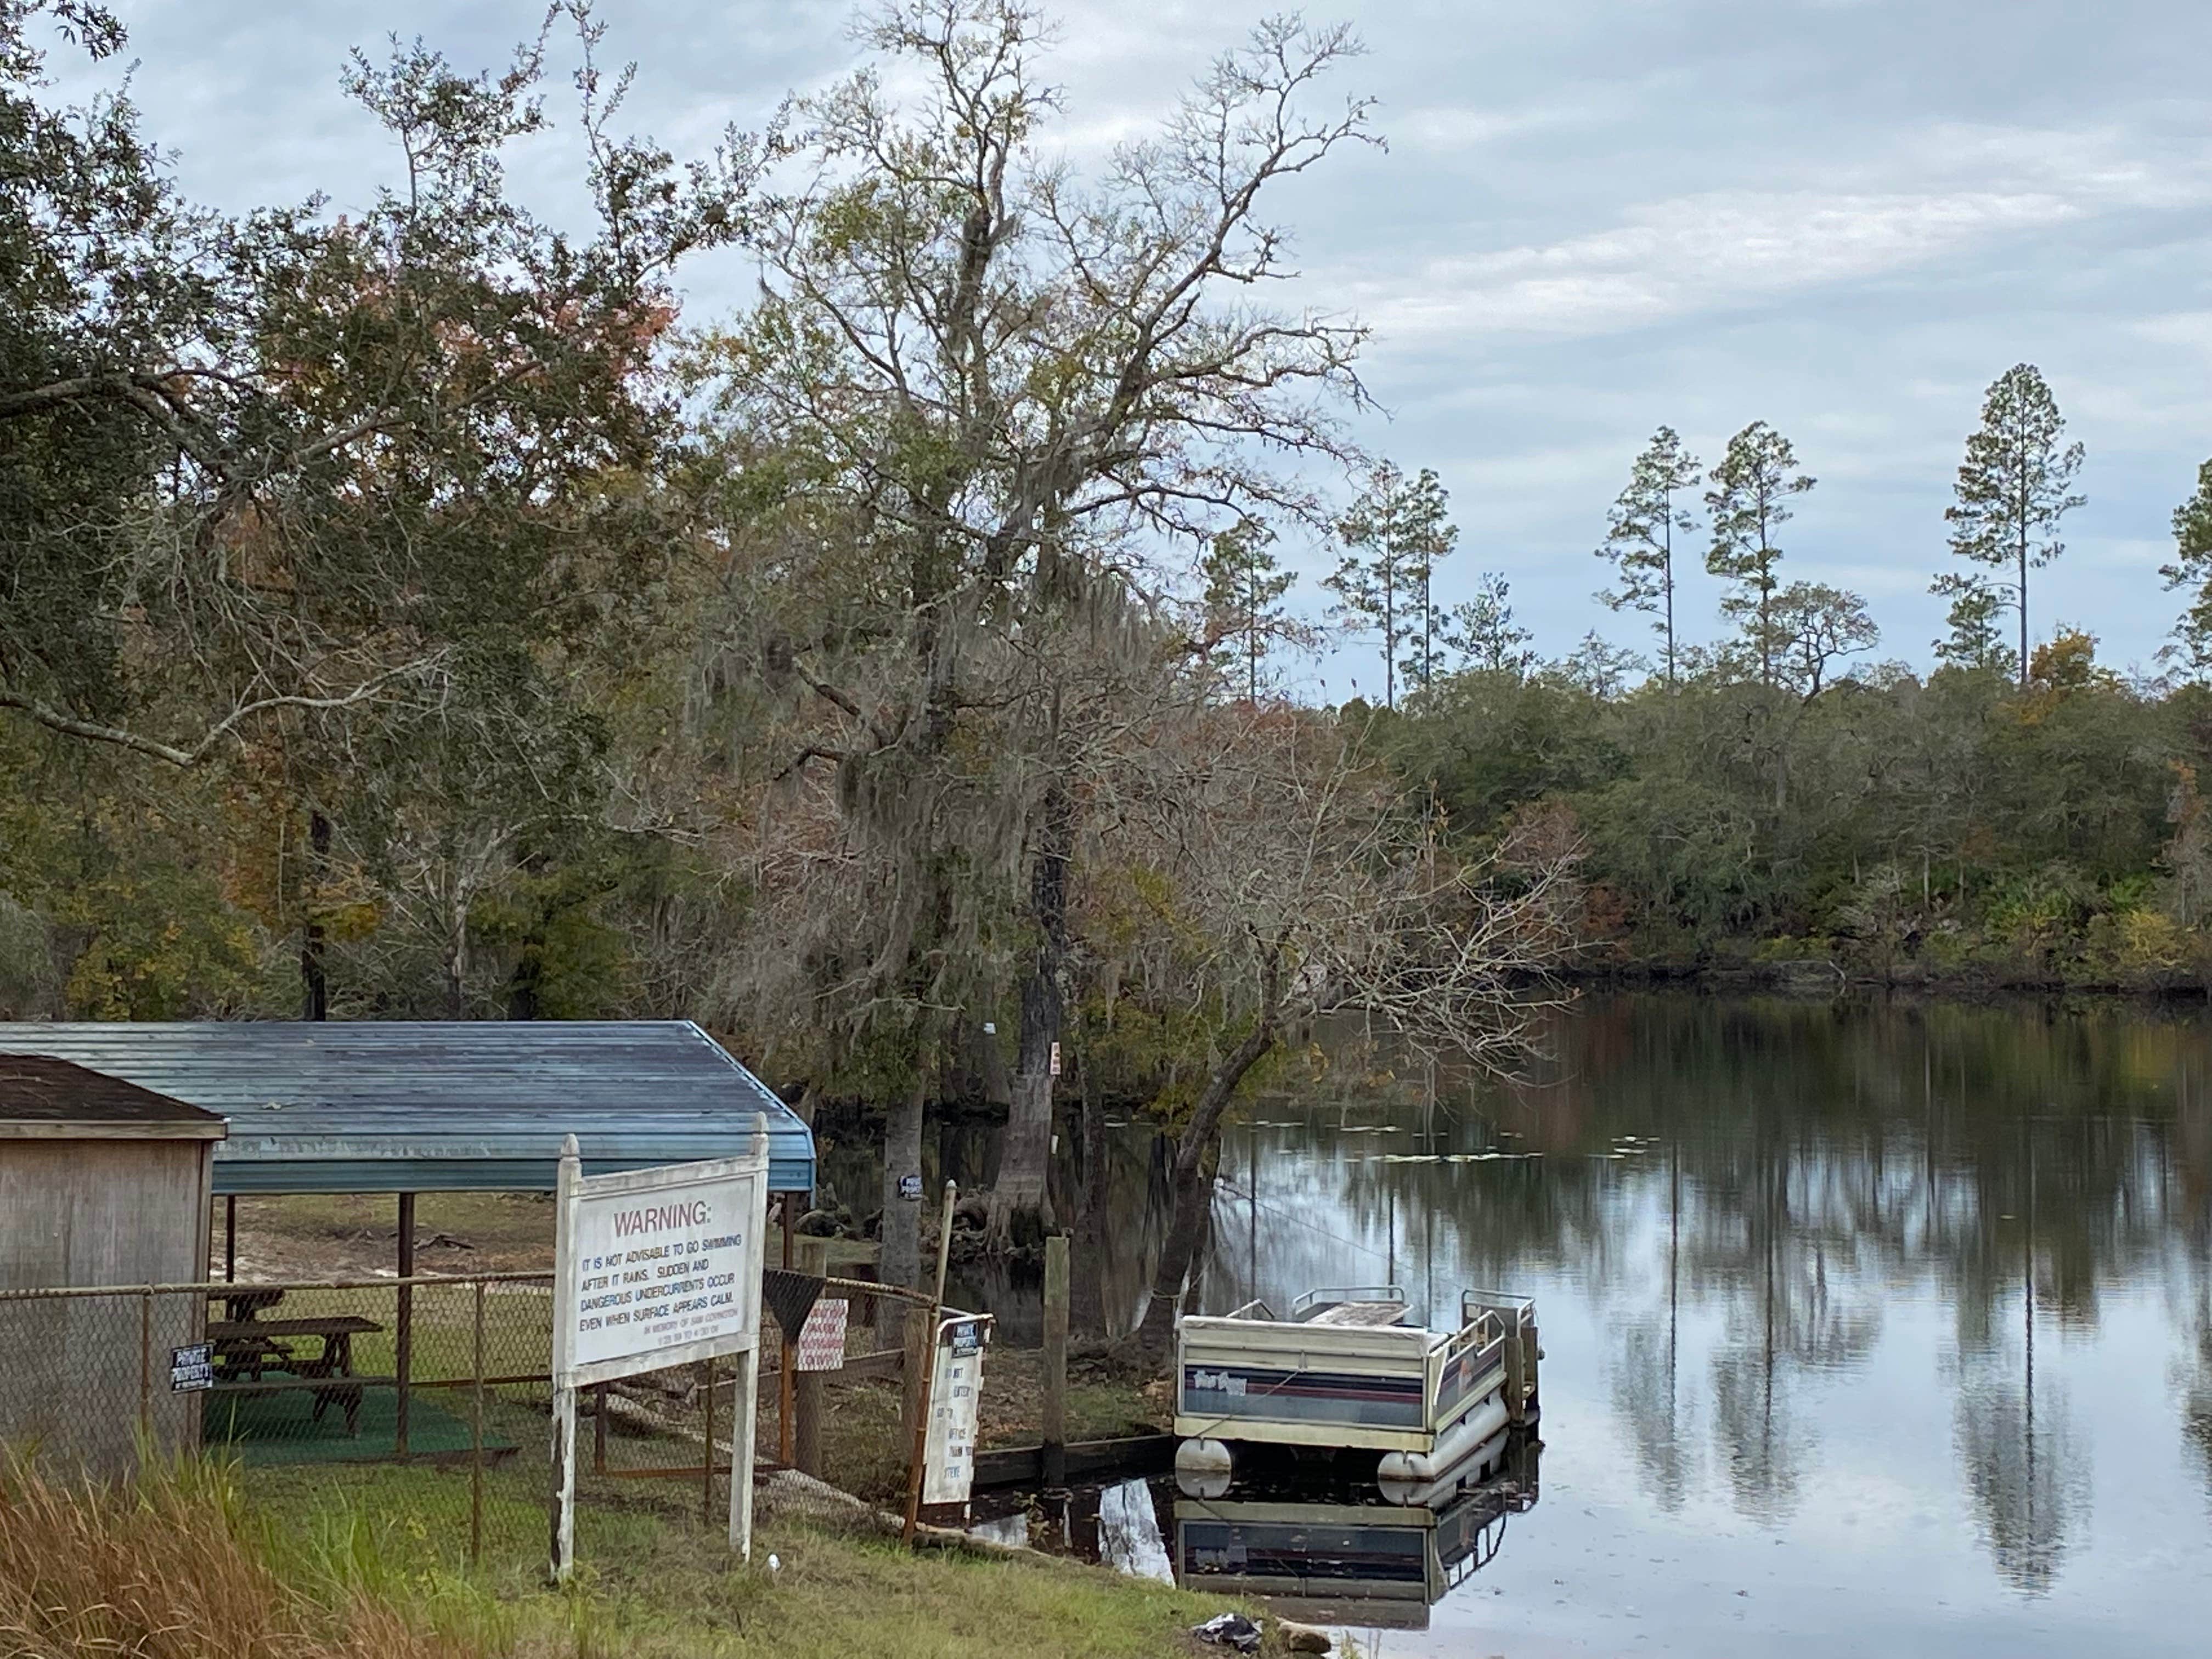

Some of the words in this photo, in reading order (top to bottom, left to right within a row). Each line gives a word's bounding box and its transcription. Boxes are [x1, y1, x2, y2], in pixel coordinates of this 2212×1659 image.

[614, 1200, 712, 1237] WARNING:
[583, 1259, 591, 1272] IT
[594, 1257, 602, 1269] IS
[606, 1254, 623, 1267] NOT
[625, 1245, 670, 1264] ADVISABLE
[673, 1243, 684, 1255] TO
[686, 1240, 698, 1254] GO
[702, 1234, 742, 1251] SWIMMING
[580, 1291, 633, 1312] DANGEROUS
[635, 1277, 704, 1302] UNDERCURRENTS
[707, 1273, 735, 1289] OCCUR
[582, 1276, 608, 1292] AFTER
[612, 1273, 619, 1286] IT
[657, 1261, 690, 1279] SUDDEN
[692, 1259, 709, 1272] AND
[579, 1317, 602, 1332] EVEN
[606, 1312, 630, 1327] WHEN
[633, 1304, 670, 1322] SURFACE
[673, 1296, 708, 1313] APPEARS
